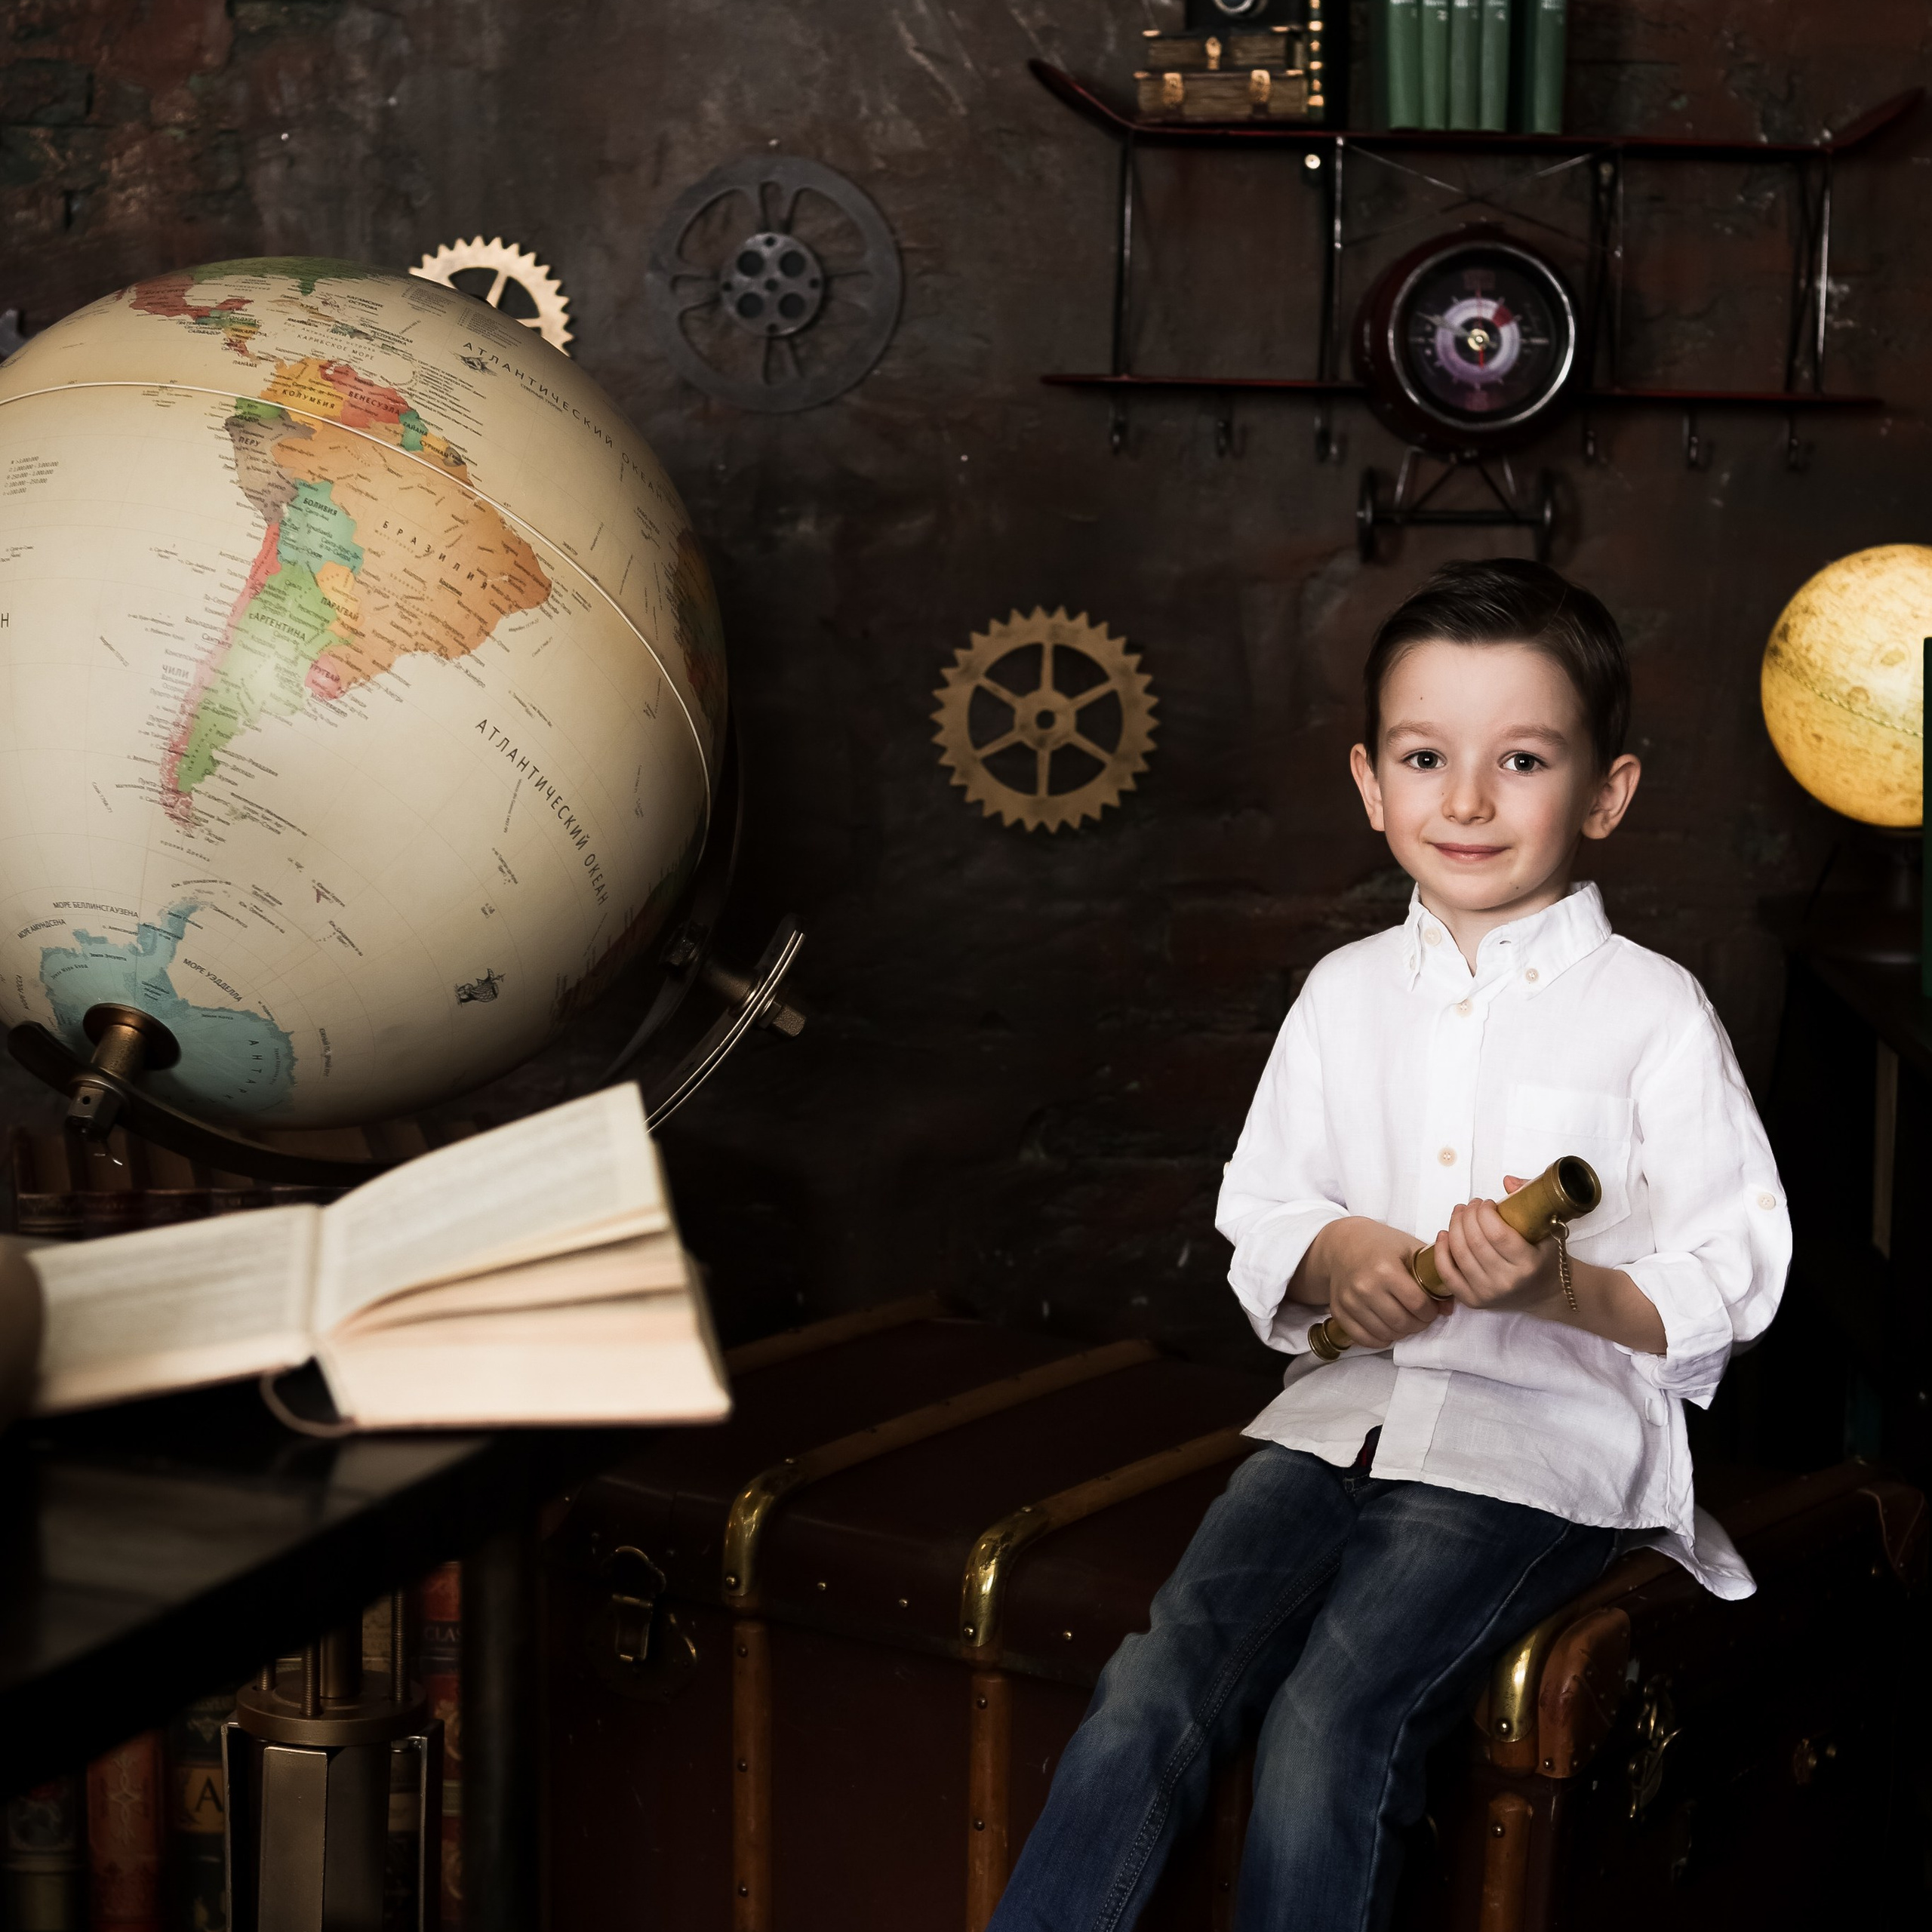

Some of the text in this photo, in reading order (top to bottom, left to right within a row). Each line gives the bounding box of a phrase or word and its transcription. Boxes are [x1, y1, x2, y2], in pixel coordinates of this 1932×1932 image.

[351, 349, 375, 361] МОРЕ
[282, 389, 336, 410] КОЛУМБИЯ
[348, 390, 400, 415] ВЕНЕСУЭЛА
[463, 341, 662, 503] АТЛАНТИЧЕСКИЙ ОКЕАН
[238, 435, 260, 447] ПЕРУ
[303, 497, 338, 517] БОЛИВИЯ
[382, 521, 488, 590] БРАЗИЛИЯ
[321, 597, 358, 621] ПАРАГВАЙ
[254, 613, 306, 641] АРГЕНТИНА
[162, 663, 189, 678] ЧИЛИ
[310, 663, 340, 682] УРУГВАЙ
[475, 718, 609, 906] АТЛАНТИЧЕСКИЙ ОКЕАН
[52, 901, 139, 918] МОРЕ БЕЛЛИНСГАУЗЕНА
[17, 918, 67, 940] МОРЕ АМУНДСЕНА
[183, 958, 242, 1002] МОРЕ УЭДДЕЛЛА
